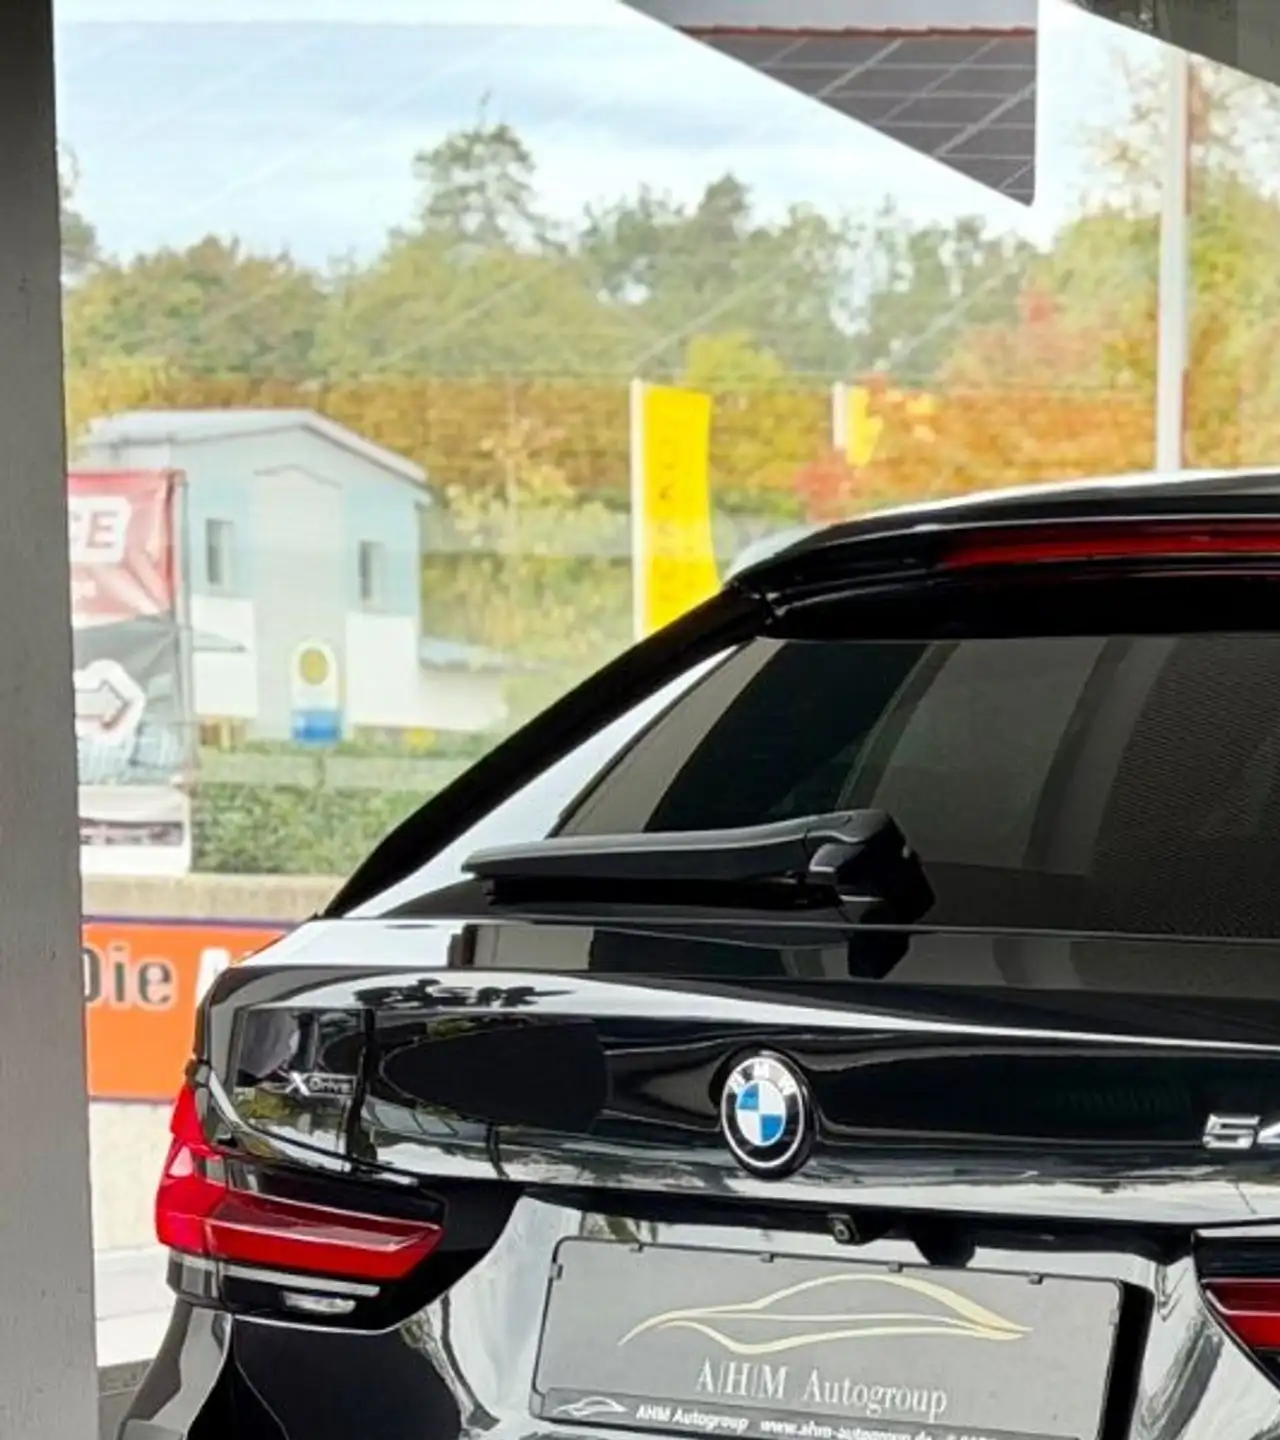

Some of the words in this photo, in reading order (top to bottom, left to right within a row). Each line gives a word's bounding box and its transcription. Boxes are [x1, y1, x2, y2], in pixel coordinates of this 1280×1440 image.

[803, 1368, 948, 1424] Autogroup
[635, 1404, 671, 1422] AHM
[672, 1407, 750, 1436] Autogroup
